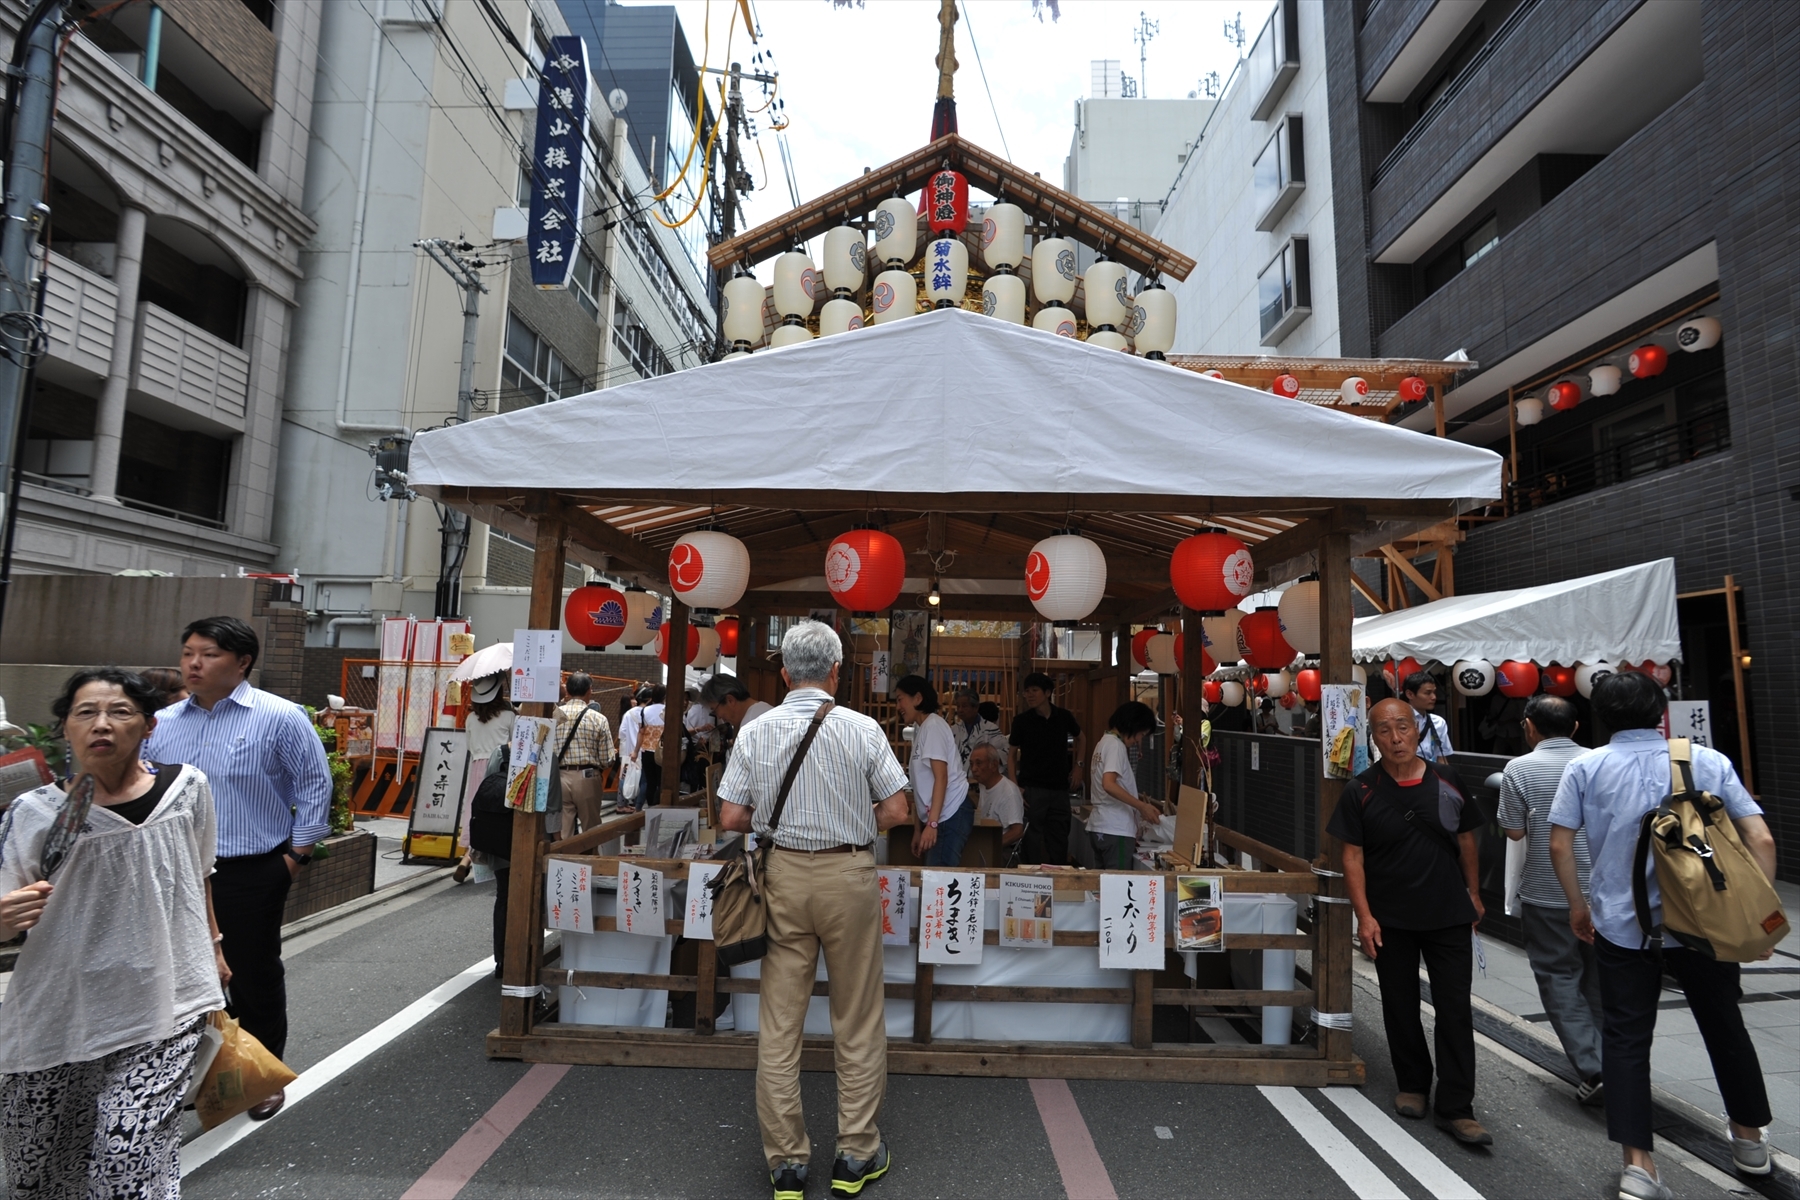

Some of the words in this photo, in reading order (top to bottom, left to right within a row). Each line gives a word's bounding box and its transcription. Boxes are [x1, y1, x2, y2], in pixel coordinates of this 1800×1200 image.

[535, 87, 574, 264] 横山株式会社
[934, 173, 957, 222] 御神燈
[932, 241, 952, 291] 菊水鉾
[432, 740, 453, 808] 大八寿司
[555, 867, 564, 909] パンフレット
[579, 867, 588, 893] 菊水鉾
[632, 870, 643, 914] ちまき
[1005, 881, 1032, 889] KIKUSUI
[1033, 883, 1052, 891] HOKO
[945, 878, 962, 955] ちまき
[965, 877, 981, 945] 菊水鉾の厄除け
